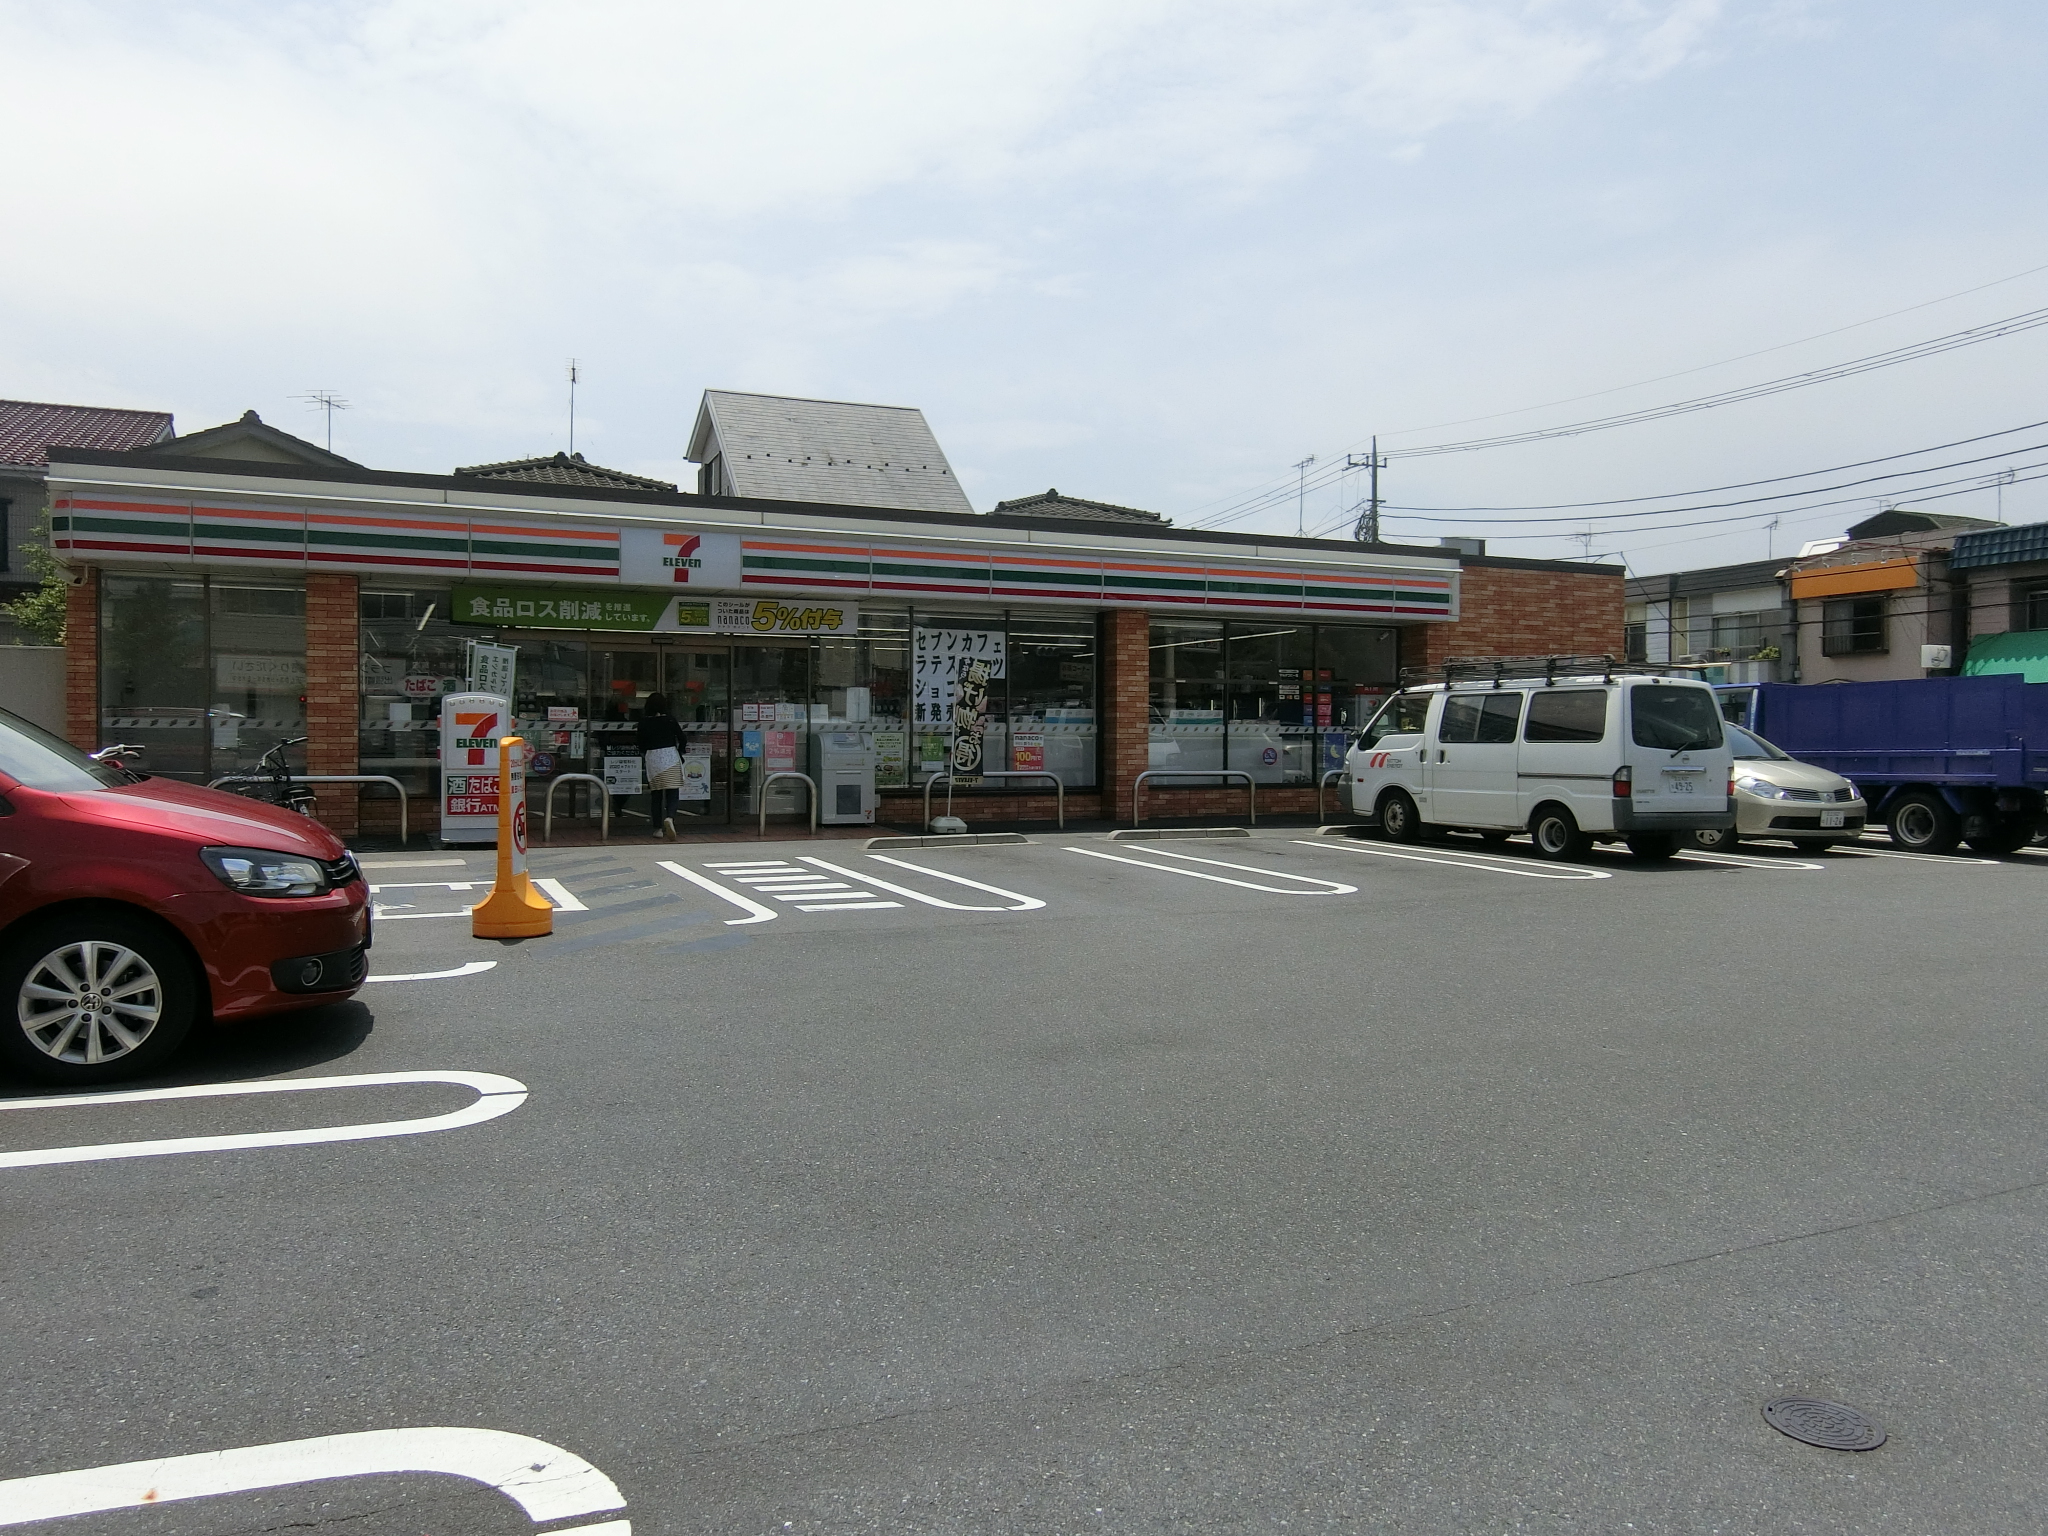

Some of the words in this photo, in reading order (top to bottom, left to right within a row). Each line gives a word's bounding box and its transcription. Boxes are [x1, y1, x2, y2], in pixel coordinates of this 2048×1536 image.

[469, 596, 602, 621] 食品ロス削減
[605, 602, 631, 612] を推進
[605, 613, 651, 623] しています。
[717, 615, 750, 626] nanaco
[751, 600, 843, 631] 5%付与
[915, 631, 1002, 654] セブンカフェ
[404, 679, 437, 692] たばこ
[442, 679, 457, 692] 酒
[448, 777, 467, 795] 酒
[1674, 782, 1694, 791] 49-25
